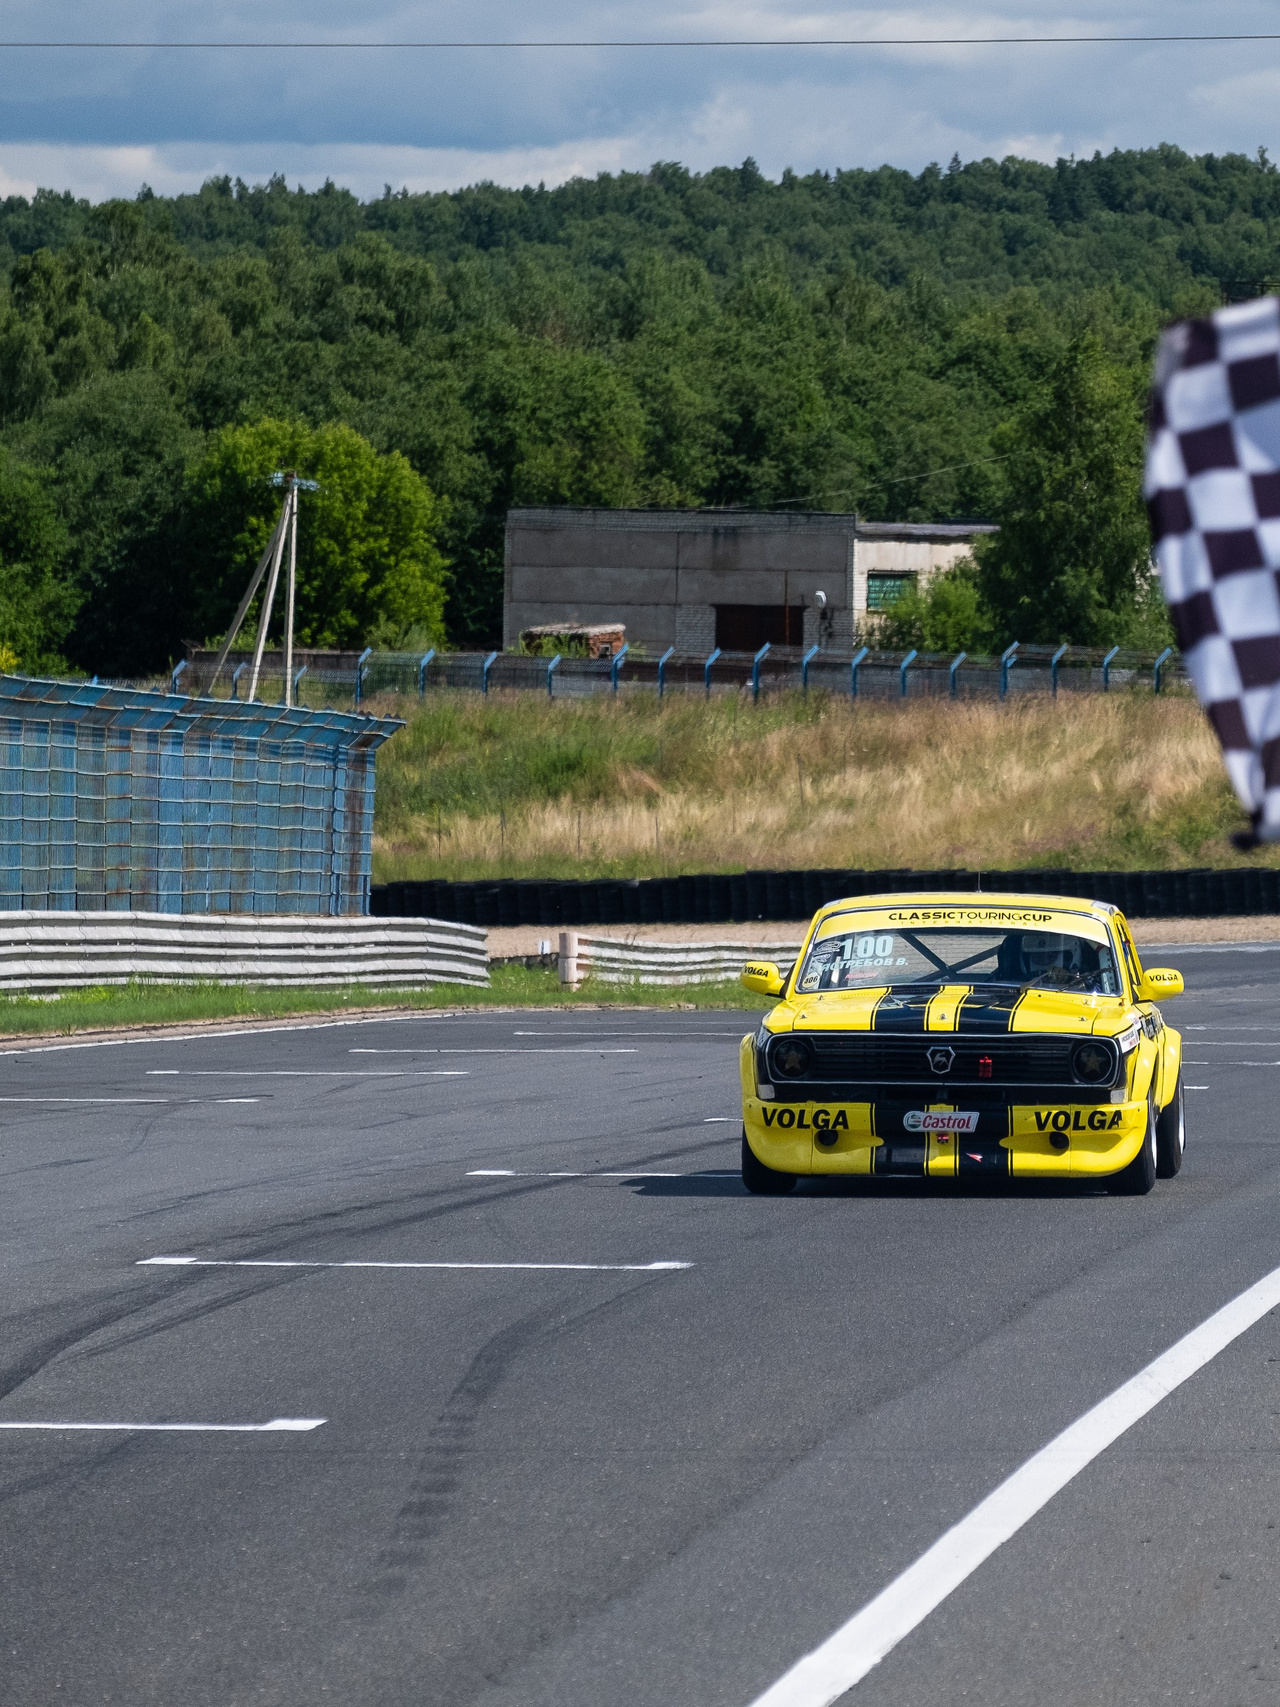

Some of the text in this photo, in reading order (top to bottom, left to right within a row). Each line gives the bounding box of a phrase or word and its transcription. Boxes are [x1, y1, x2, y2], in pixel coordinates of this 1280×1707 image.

[888, 911, 1052, 922] CLASSICTOURINGCUP
[839, 936, 893, 960] 100
[744, 966, 769, 978] VOLGA
[1149, 973, 1179, 982] VOLGA
[761, 1106, 850, 1130] VOLGA
[922, 1115, 972, 1129] Castrol
[1034, 1109, 1123, 1131] VOLGA
